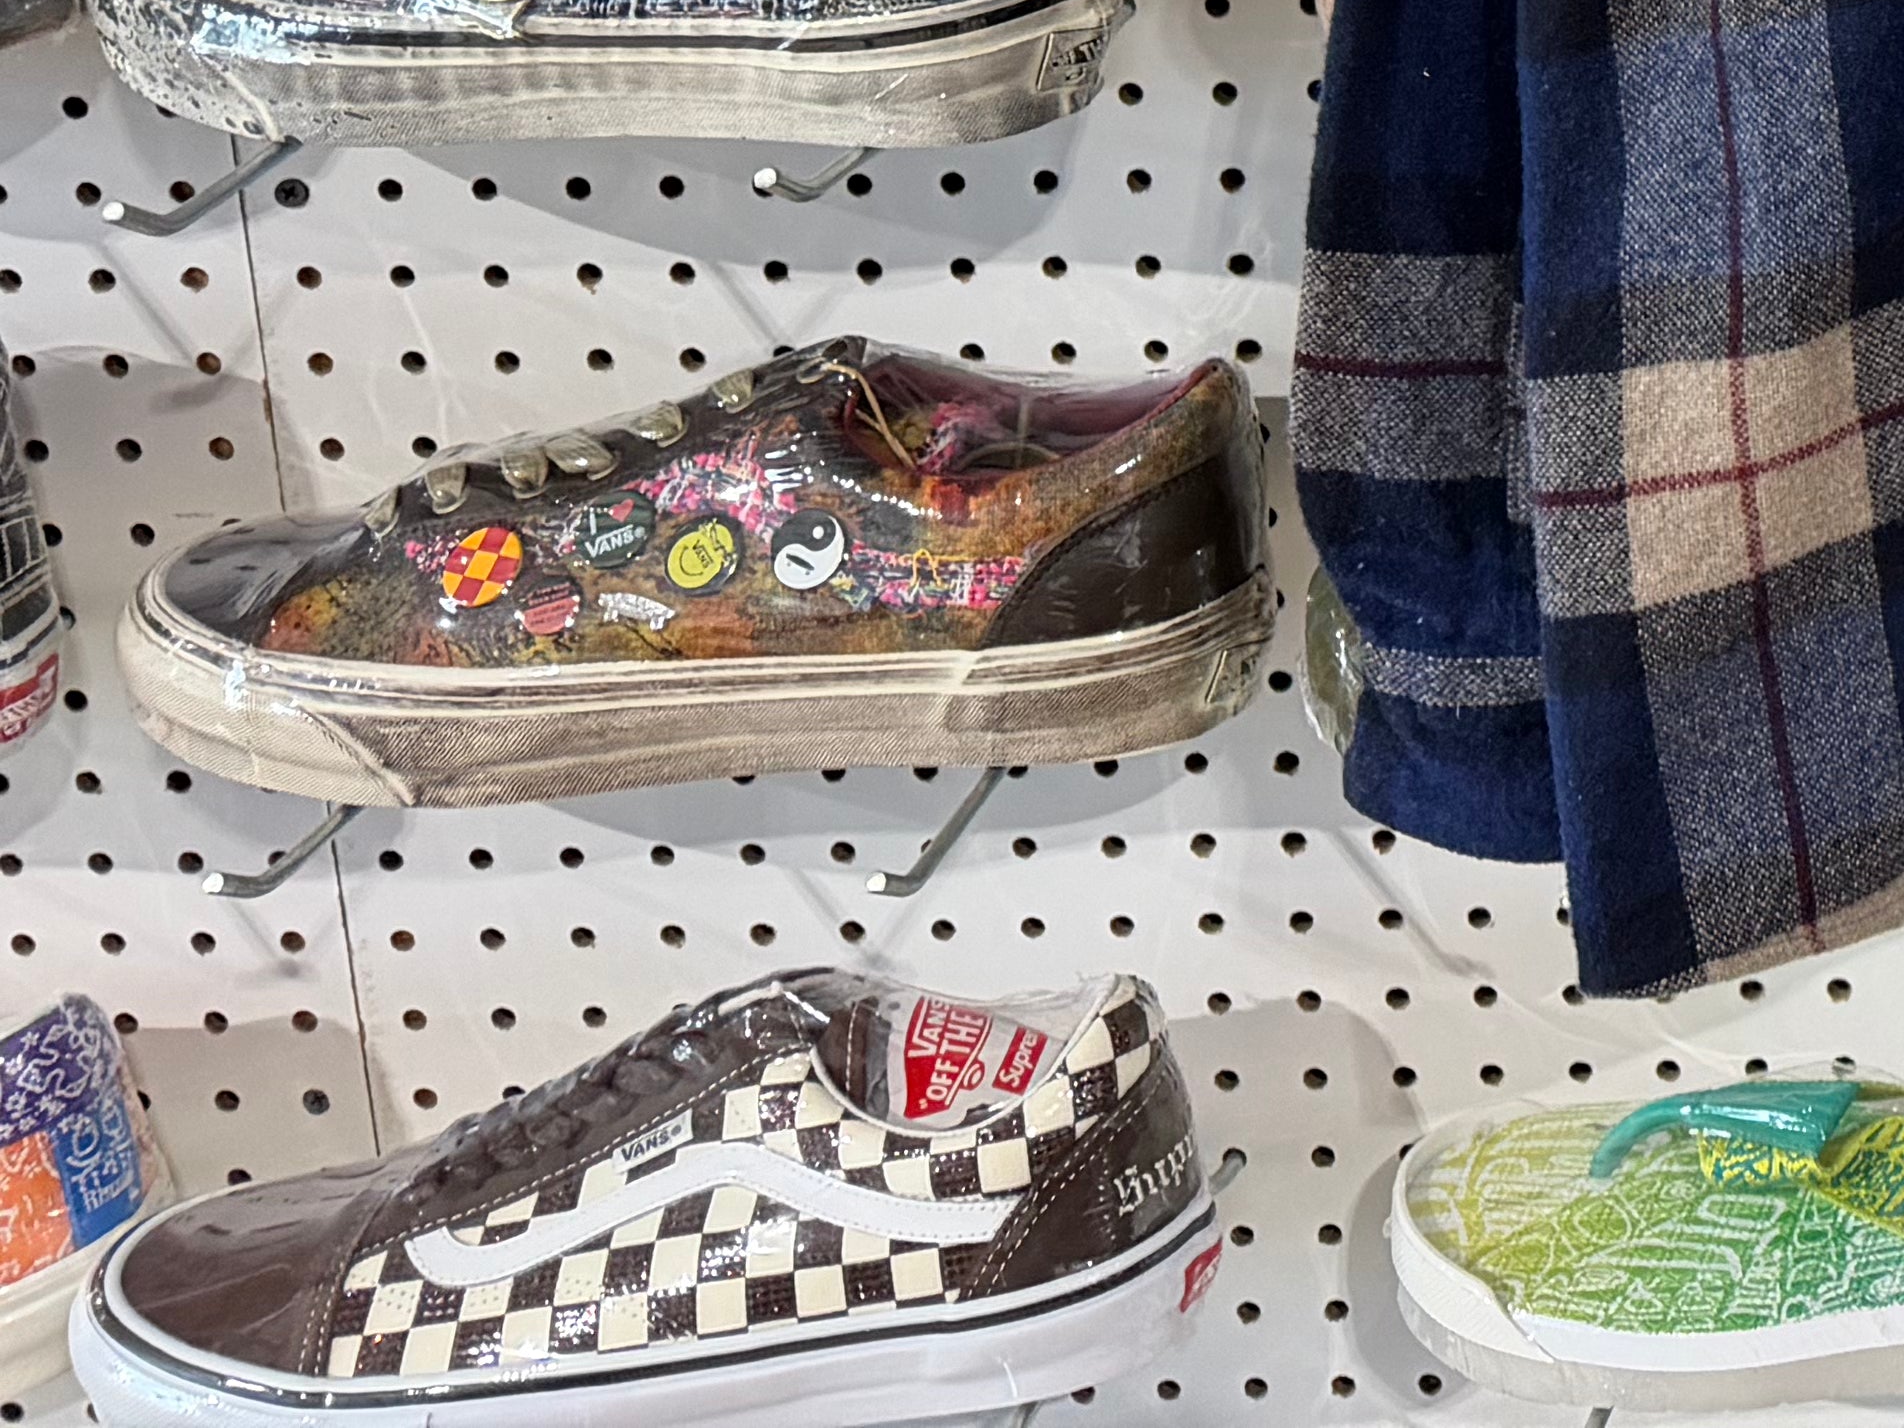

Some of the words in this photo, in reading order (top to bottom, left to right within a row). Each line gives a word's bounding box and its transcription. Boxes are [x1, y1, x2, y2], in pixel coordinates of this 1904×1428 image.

[589, 507, 598, 536] I
[584, 524, 635, 559] VANS
[692, 538, 714, 569] VANS
[620, 1125, 671, 1162] VANS
